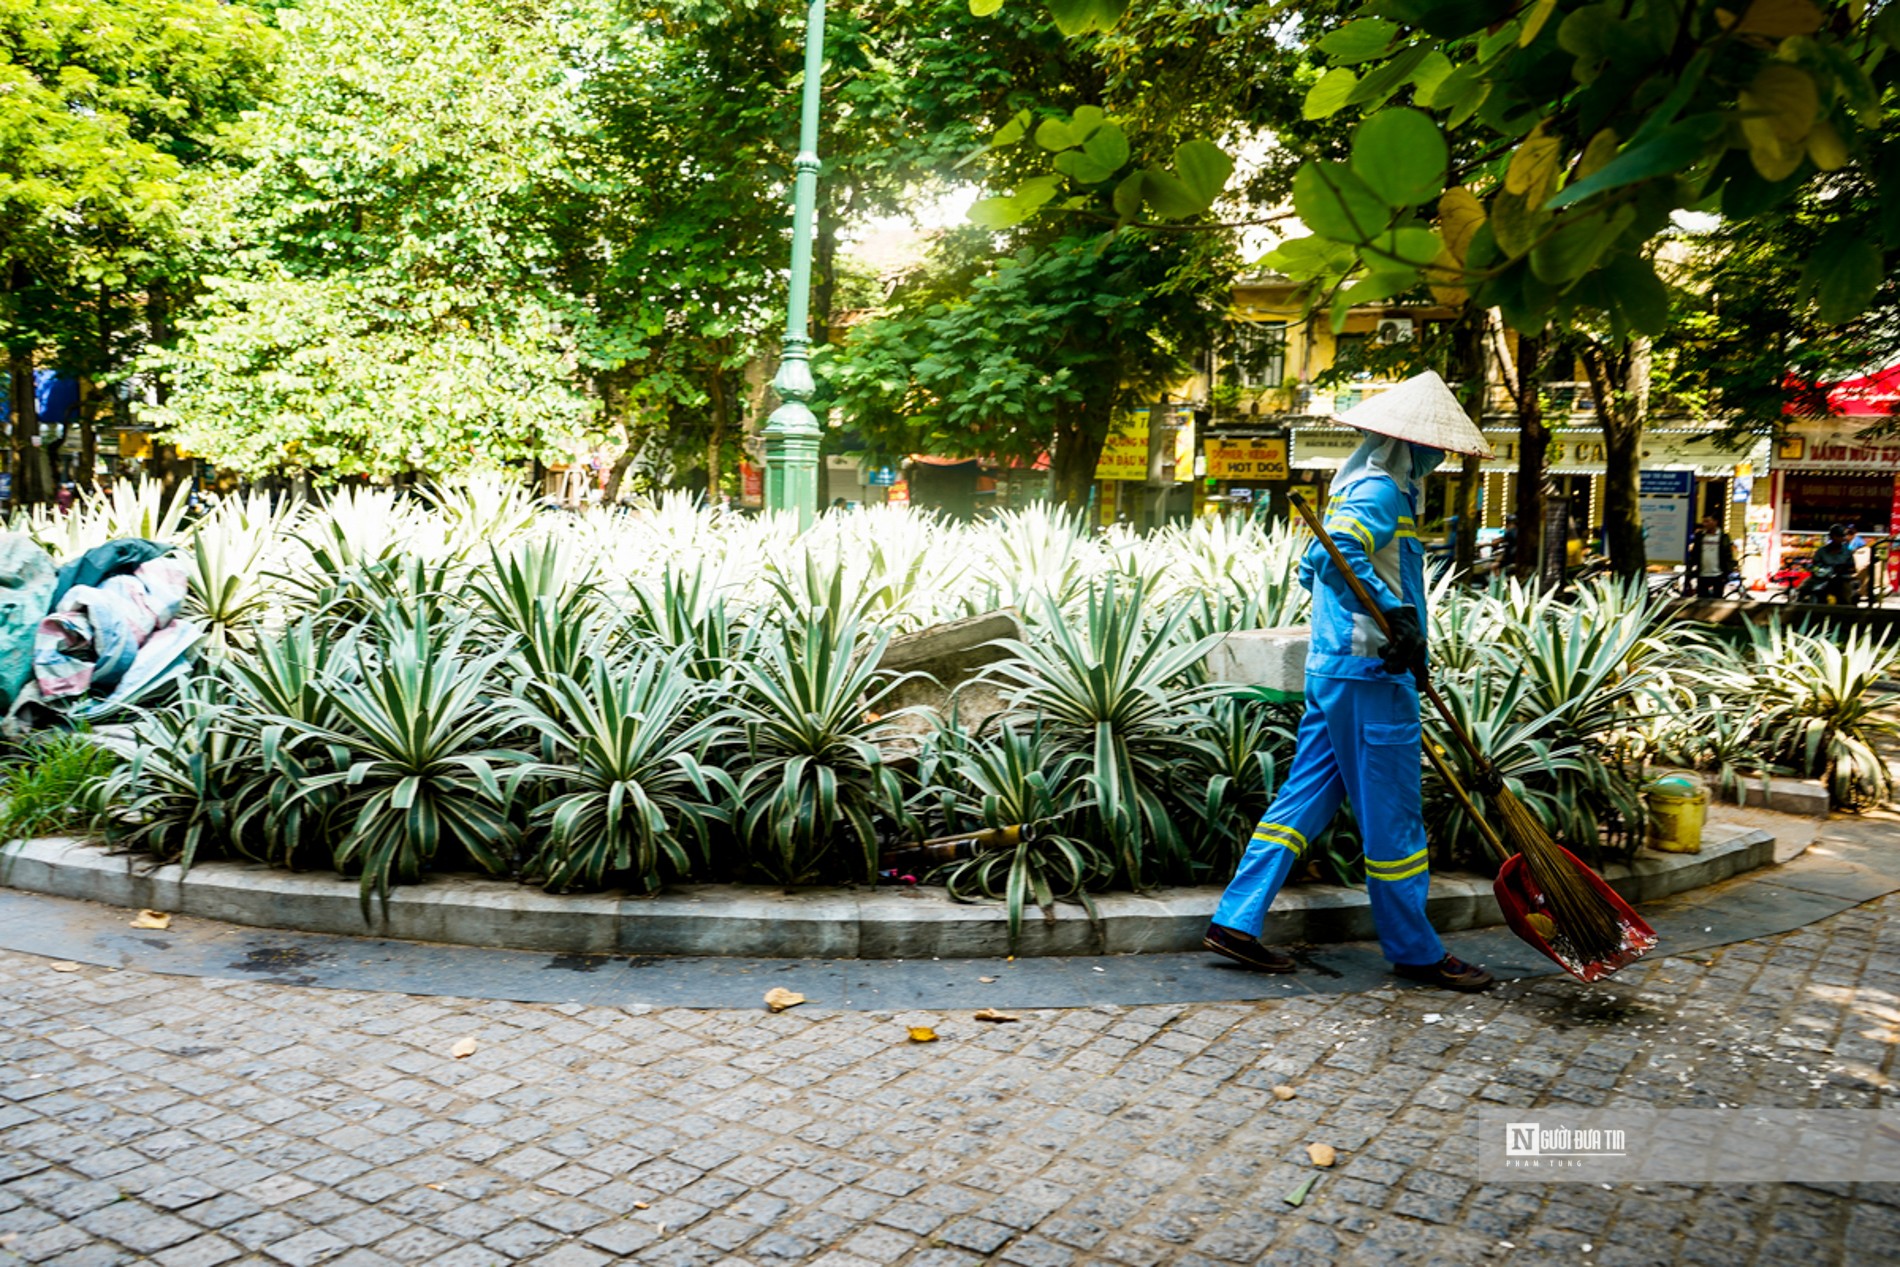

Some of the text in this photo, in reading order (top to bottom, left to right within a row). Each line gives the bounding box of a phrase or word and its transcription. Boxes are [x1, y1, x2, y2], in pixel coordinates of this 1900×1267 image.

[1575, 441, 1607, 461] CA
[1228, 462, 1283, 472] HOT DOG
